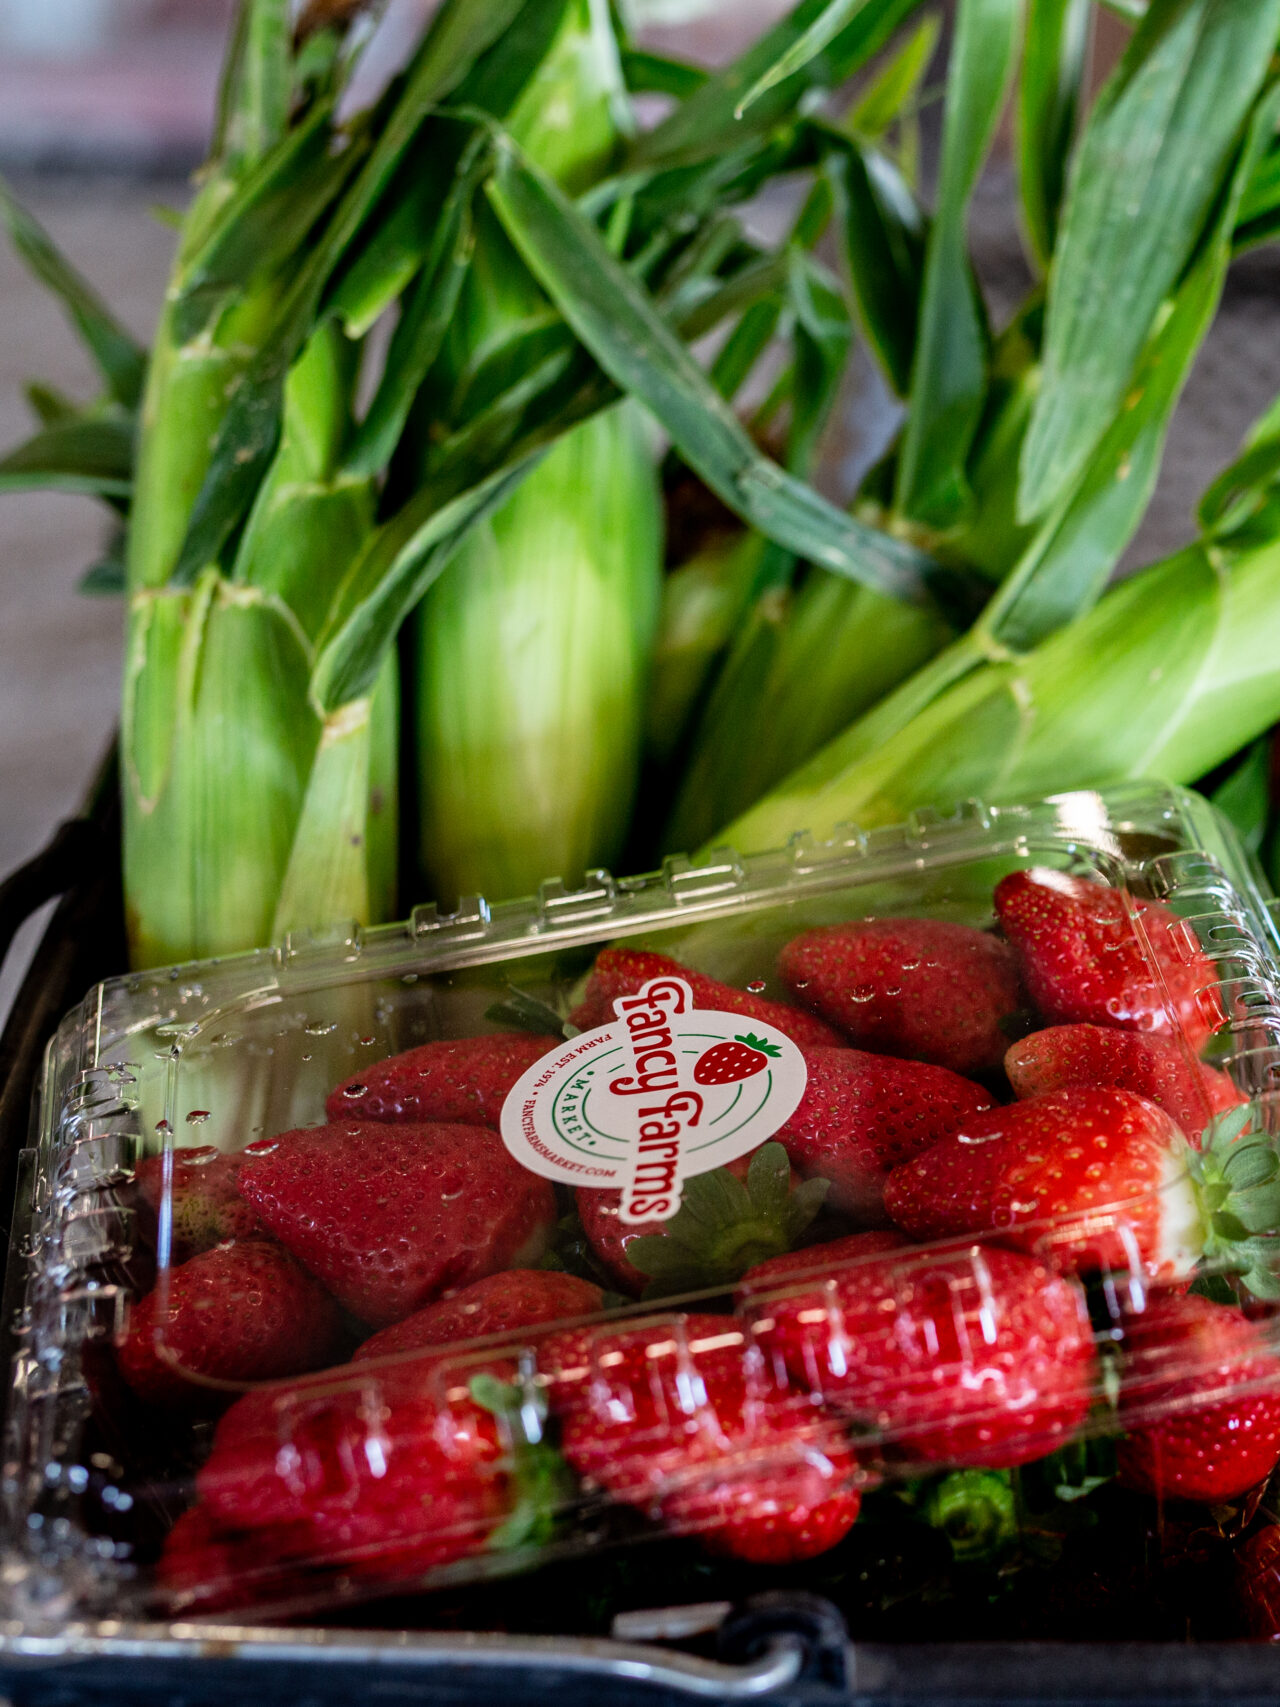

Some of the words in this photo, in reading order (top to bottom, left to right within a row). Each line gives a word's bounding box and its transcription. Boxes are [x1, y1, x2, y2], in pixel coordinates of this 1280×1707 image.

[550, 1053, 577, 1071] EST.
[575, 1033, 612, 1055] FARM
[609, 980, 685, 1096] Fancy
[533, 1069, 556, 1089] 1974
[561, 1078, 591, 1143] MARKET
[521, 1099, 617, 1178] FANCYFARMSMARKET.COM
[629, 1090, 704, 1217] Farms
